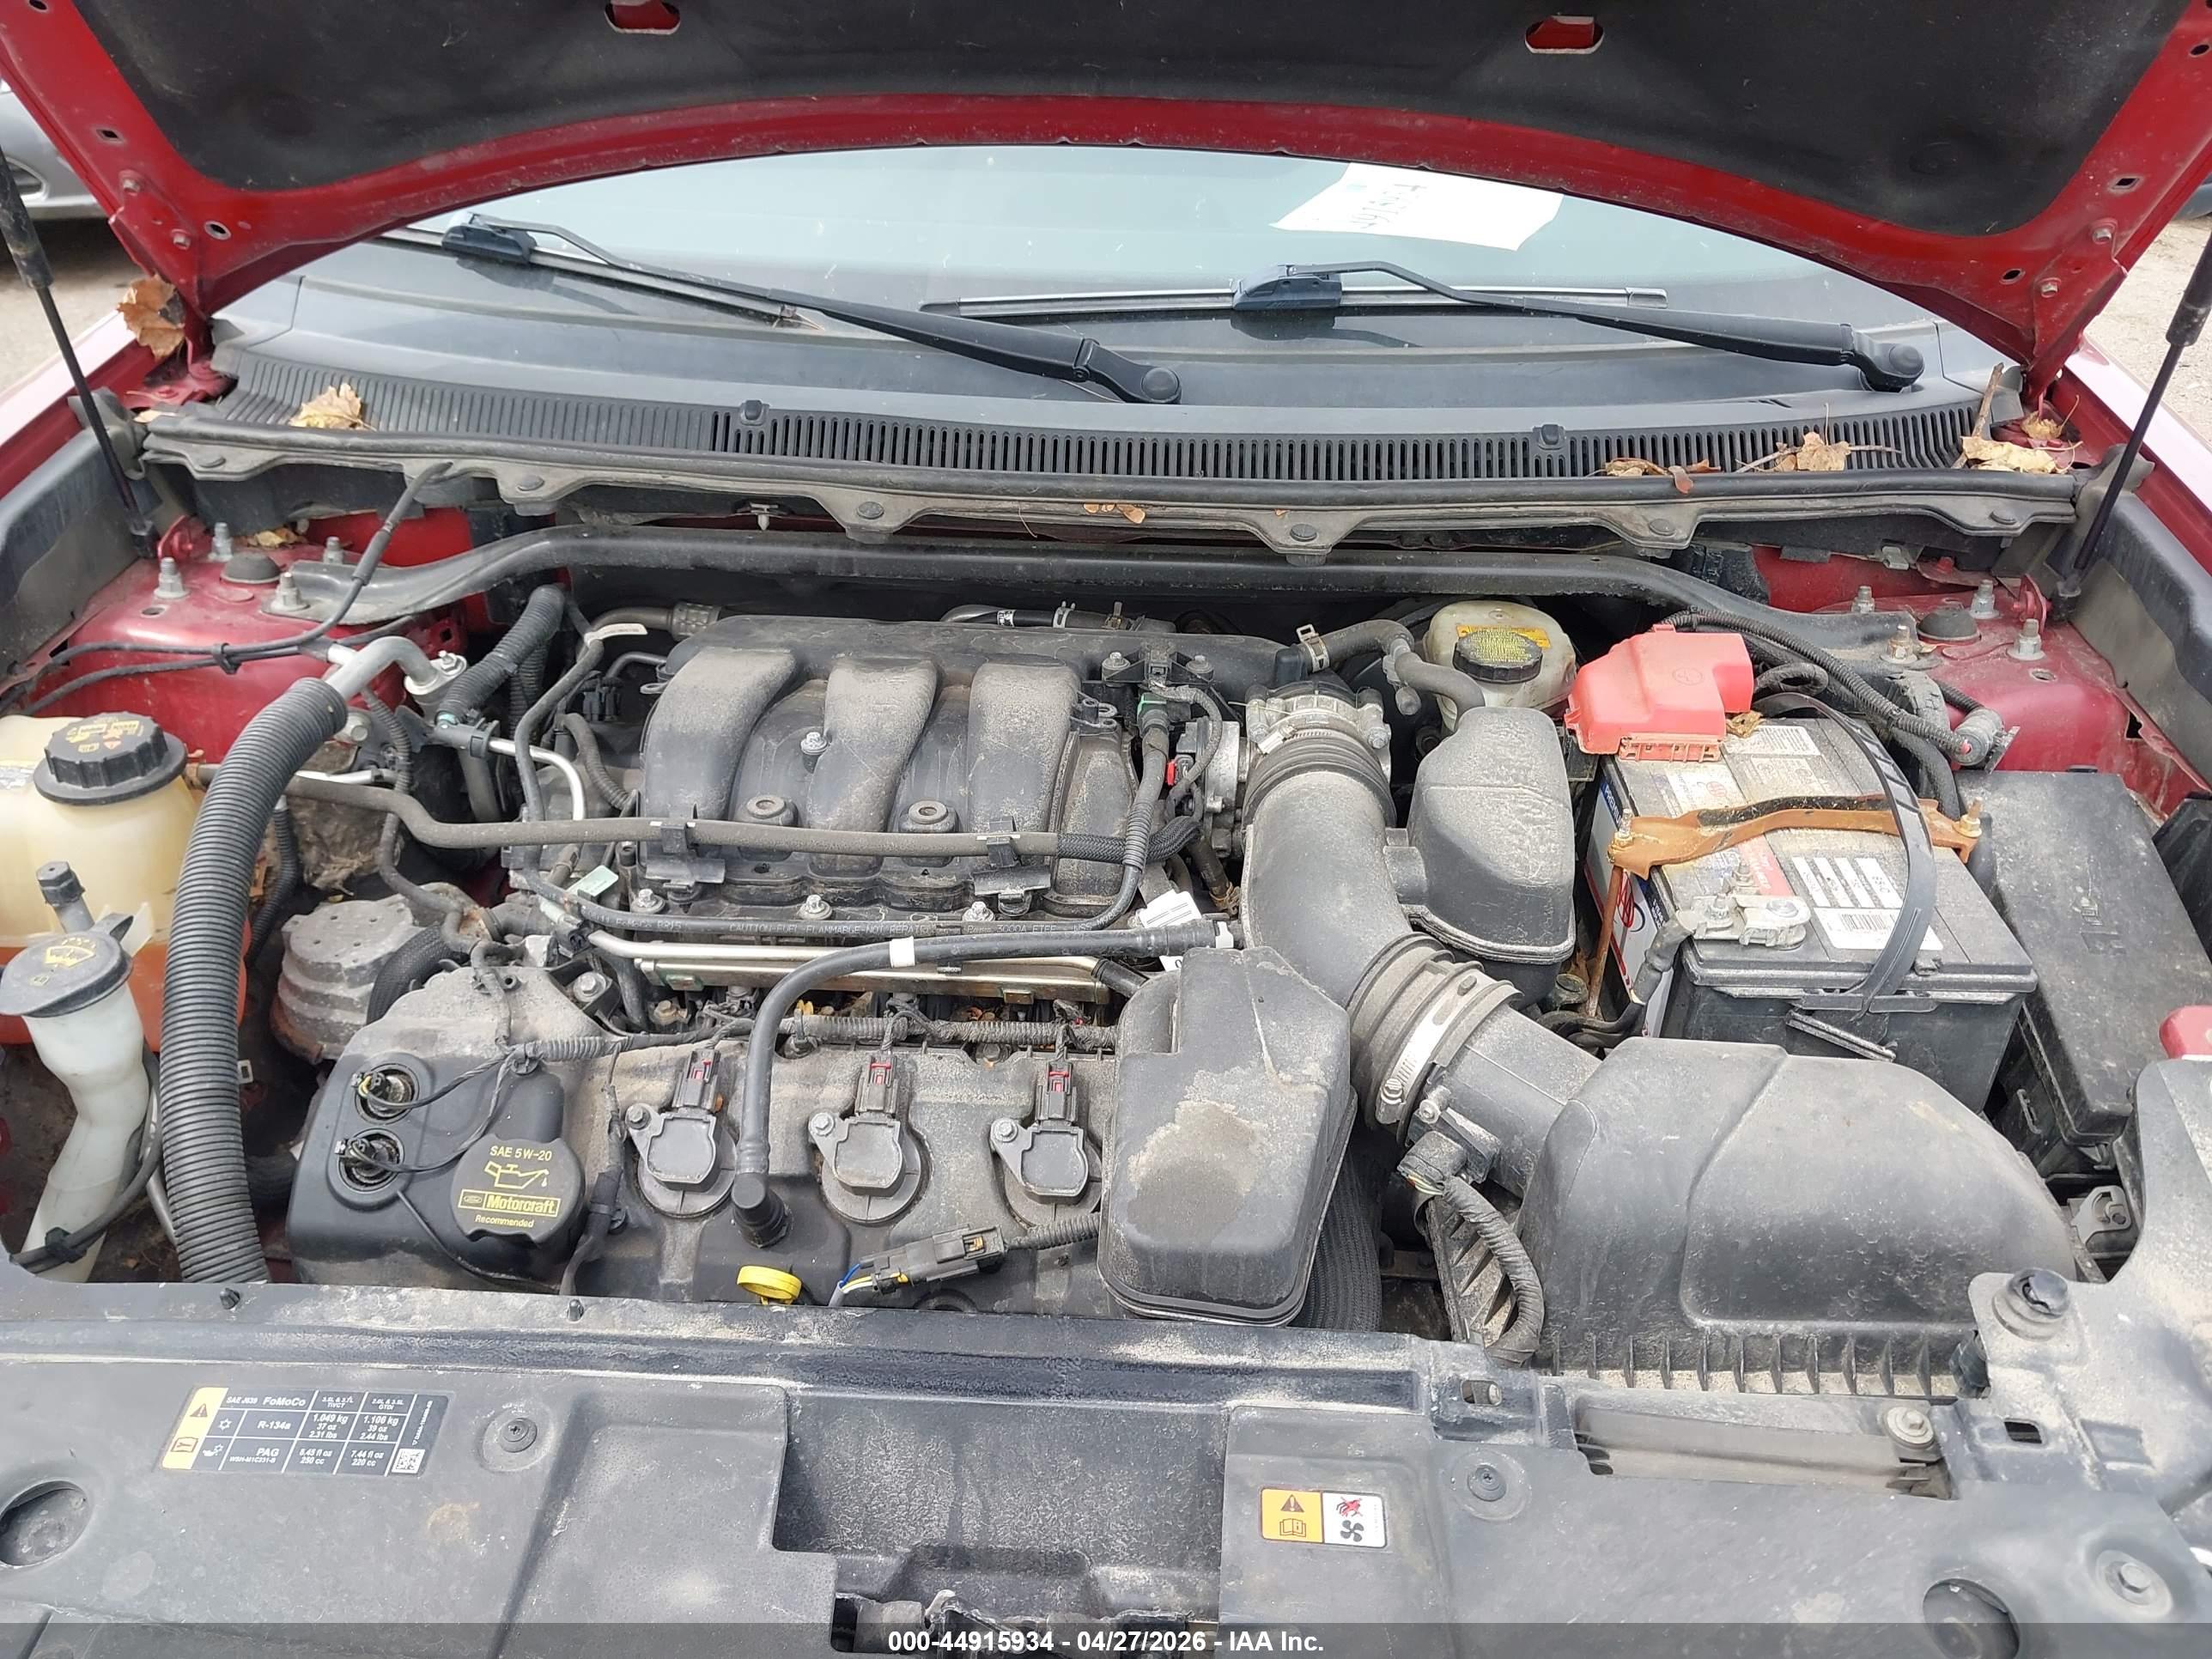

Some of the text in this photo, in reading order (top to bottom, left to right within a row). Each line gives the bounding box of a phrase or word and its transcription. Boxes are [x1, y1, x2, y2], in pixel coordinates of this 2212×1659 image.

[489, 1146, 552, 1161] SAE 5W-20
[475, 1214, 534, 1228] Recommended
[262, 1396, 306, 1407] FoMoCo
[313, 1413, 349, 1425] 1.049 kg
[363, 1415, 399, 1426] 1.106 kg
[257, 1420, 291, 1430] R-134a
[325, 1431, 337, 1439] lbs
[378, 1432, 389, 1441] lbs
[256, 1448, 280, 1457] PAG
